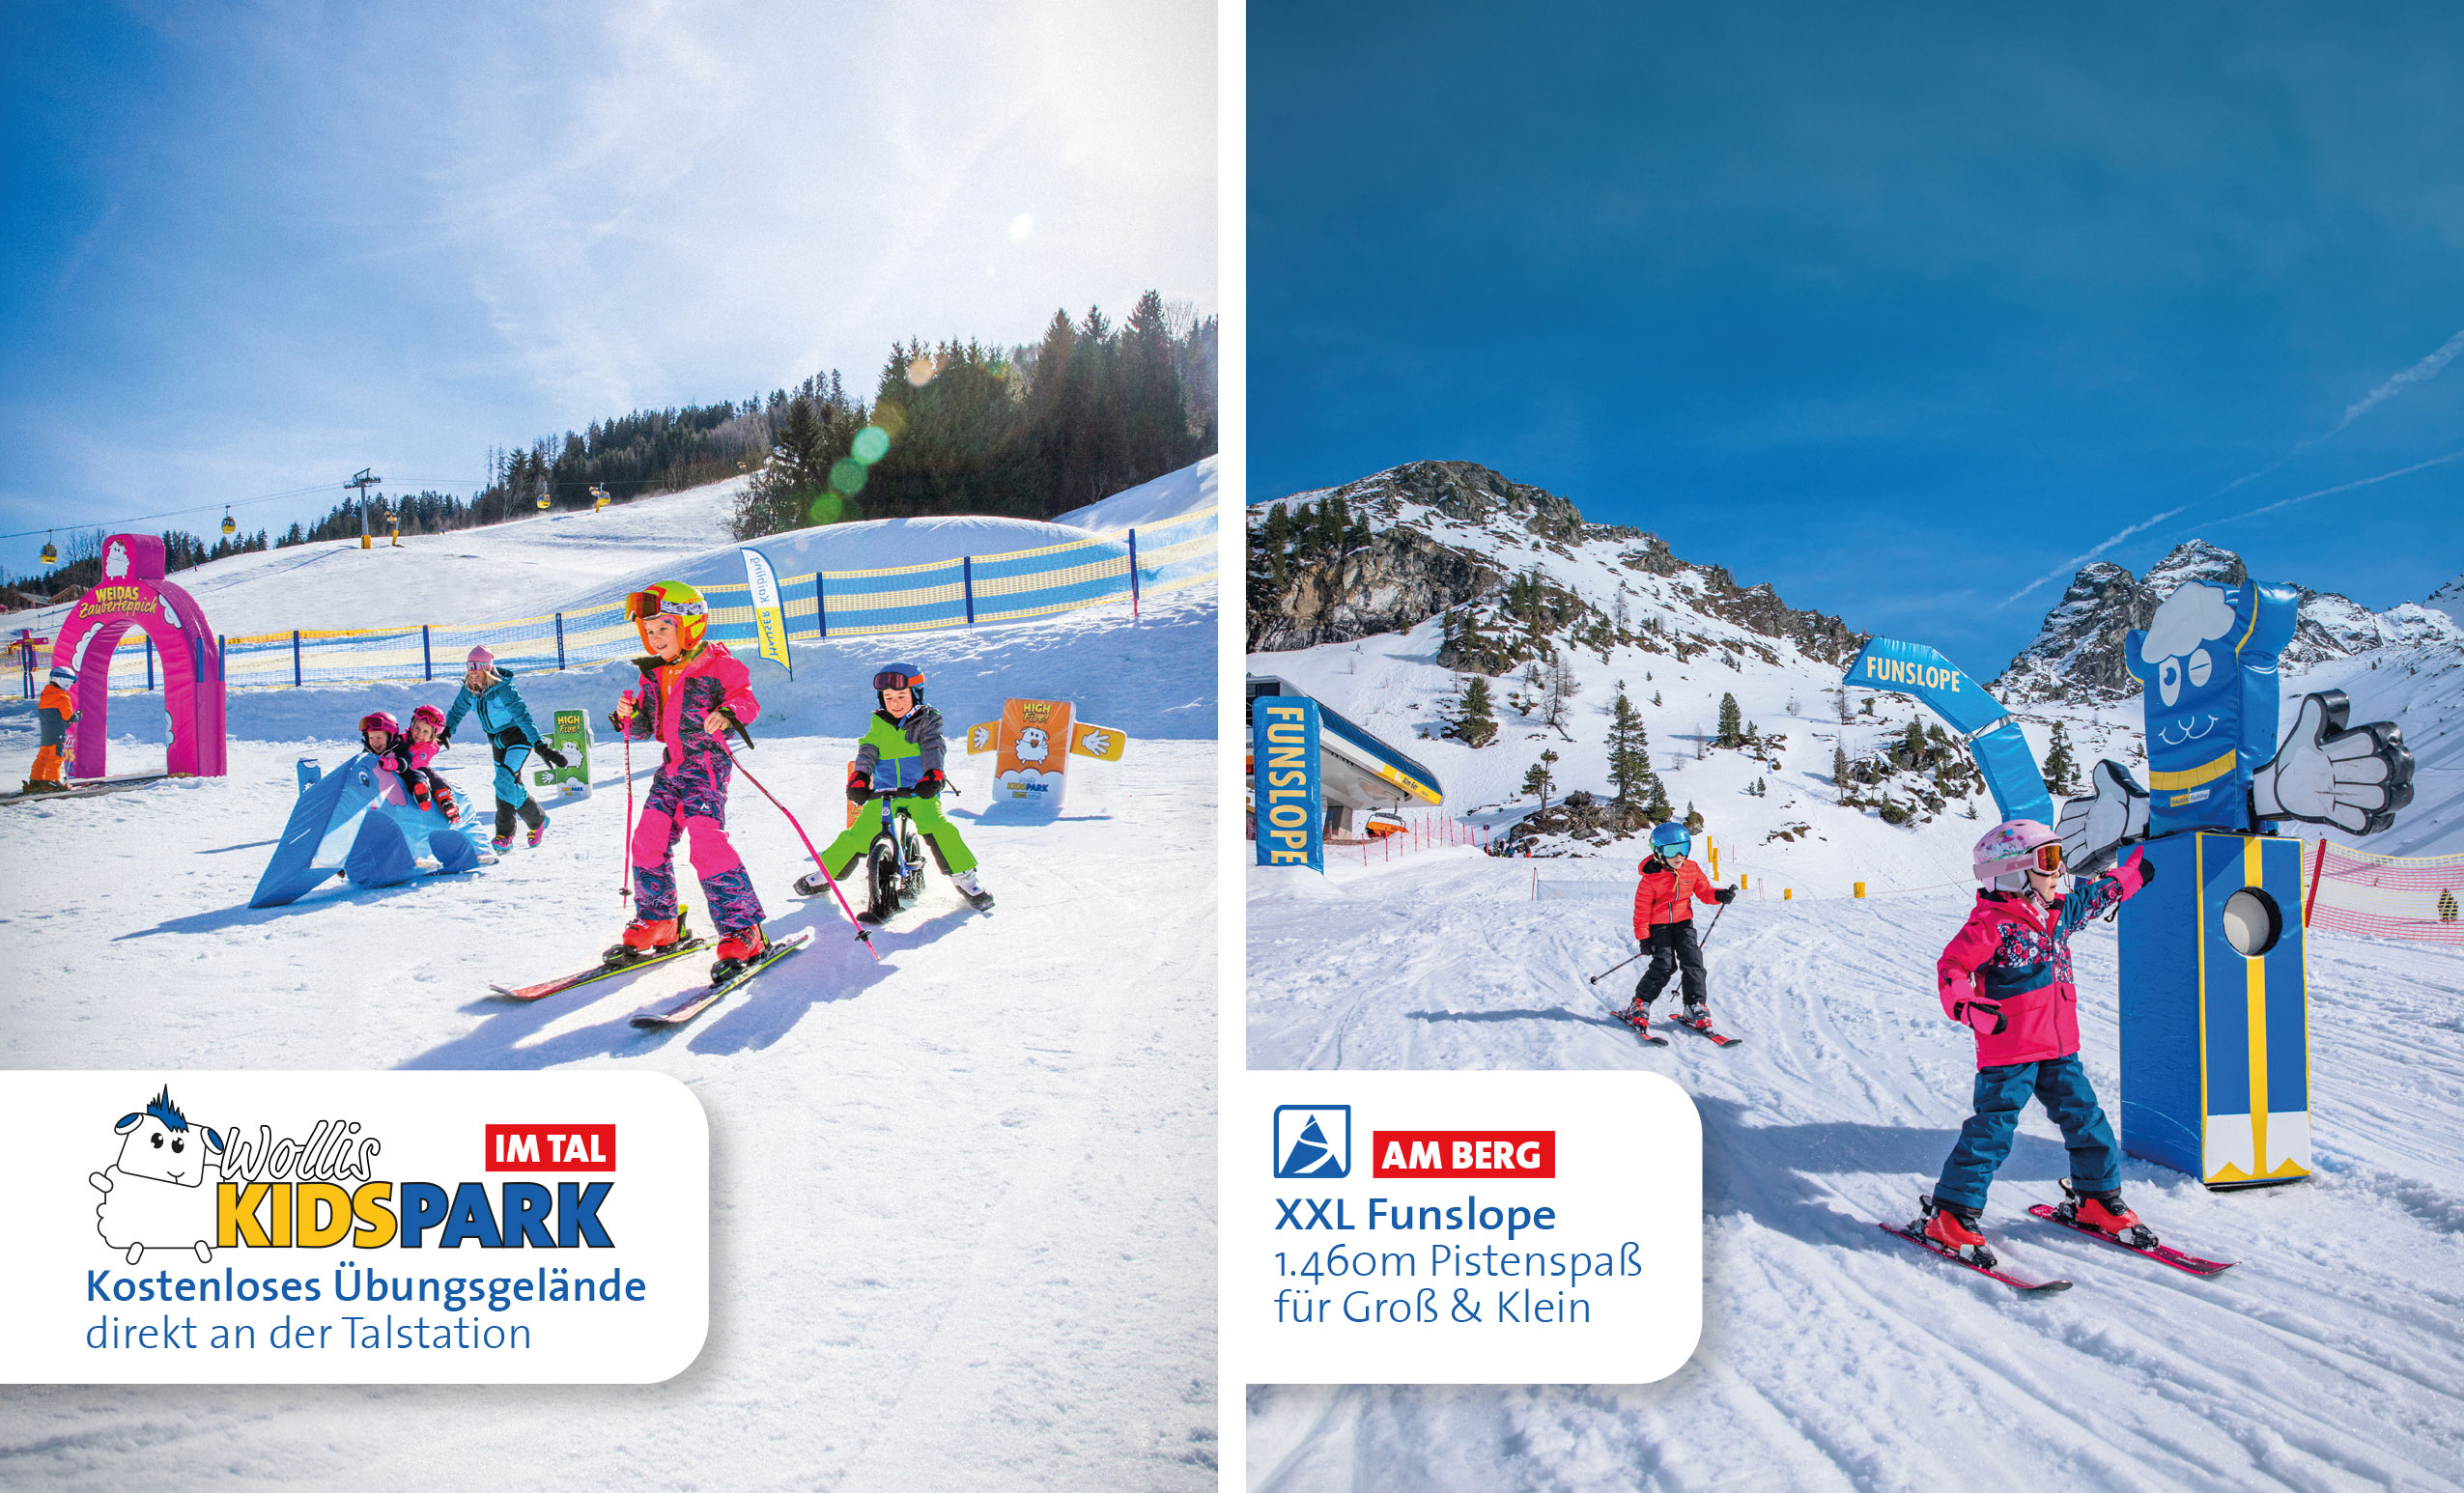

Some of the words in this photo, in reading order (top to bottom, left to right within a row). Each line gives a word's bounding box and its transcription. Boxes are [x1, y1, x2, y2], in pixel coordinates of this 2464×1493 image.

[95, 586, 139, 604] WEIDAS
[79, 597, 157, 619] Zauberteppich
[1867, 656, 1961, 692] FUNSLOPE
[1023, 703, 1051, 715] HIGH
[557, 716, 581, 725] HIGH
[1023, 713, 1050, 723] Five!
[559, 724, 580, 735] Five!
[1266, 707, 1308, 864] FUNSLOPE
